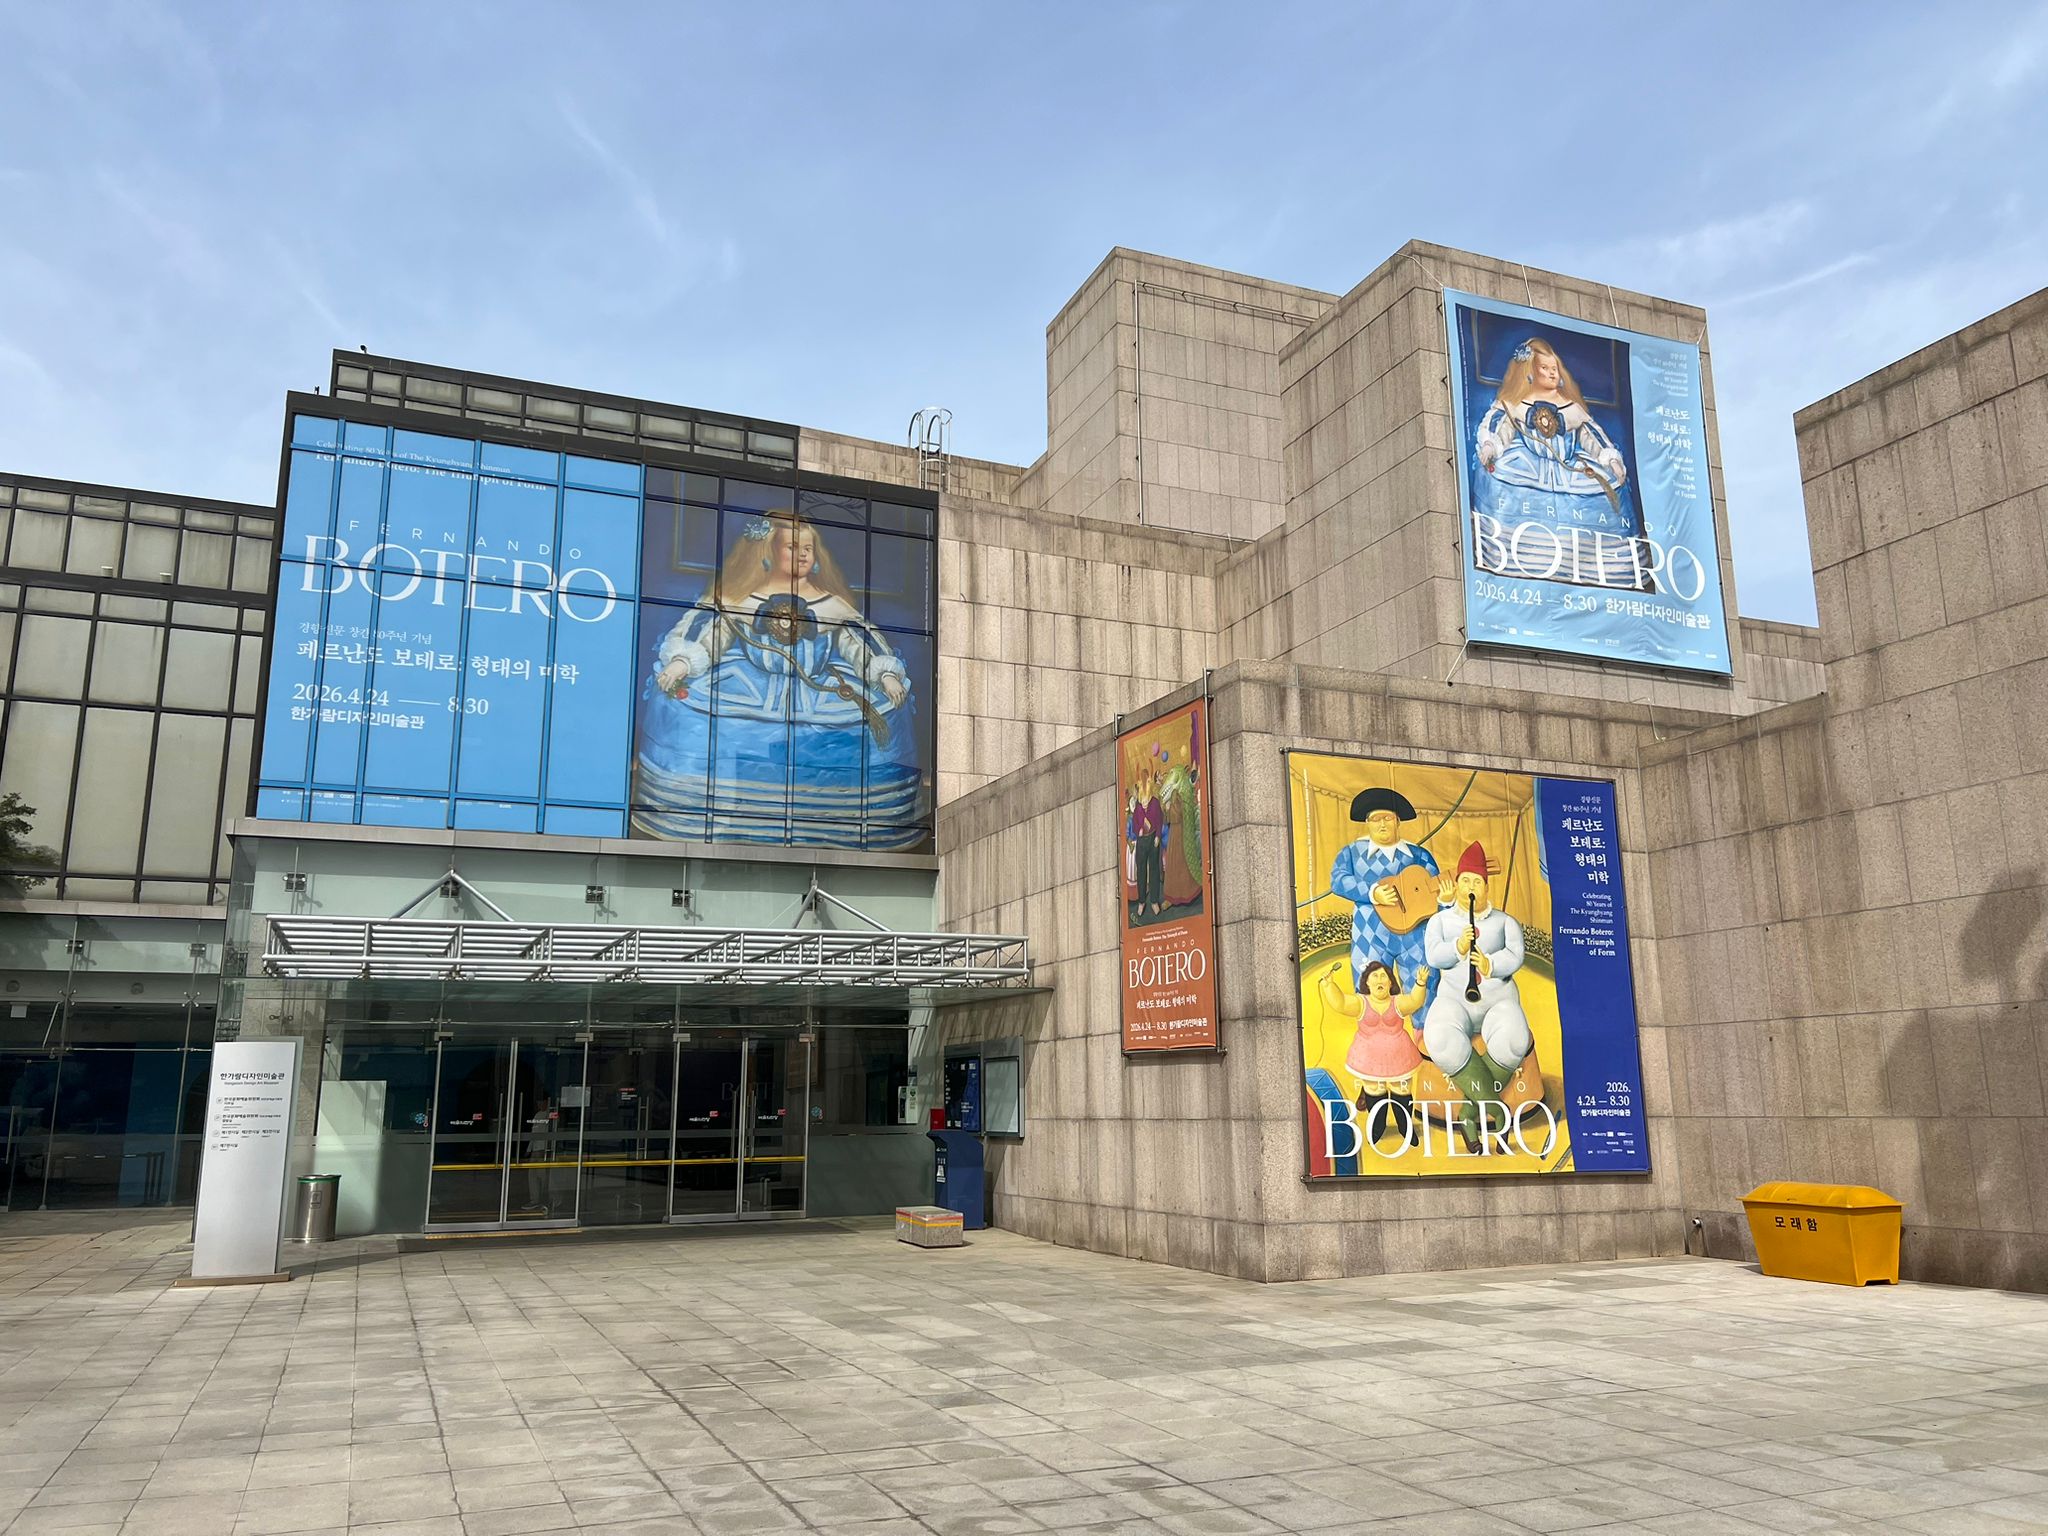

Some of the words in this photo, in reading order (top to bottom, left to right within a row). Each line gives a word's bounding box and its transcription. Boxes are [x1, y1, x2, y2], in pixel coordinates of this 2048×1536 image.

[475, 462, 511, 473] hinmun
[1498, 498, 1677, 537] FERNANDO
[349, 520, 582, 560] FERNANDO
[1472, 510, 1705, 601] BOTERO
[300, 534, 617, 623] BOTERO
[1475, 580, 1543, 606] 2026.4.24
[1563, 593, 1597, 612] 8.30
[1605, 598, 1711, 630] 한가람디자인미술관
[411, 632, 432, 645] 기념
[296, 639, 385, 664] 페르난도
[391, 648, 462, 672] 보테로:
[471, 655, 531, 681] 형태의
[538, 663, 580, 685] 미학
[292, 683, 390, 707] 2026.4.24
[447, 696, 489, 715] 8.30
[291, 706, 425, 730] 한가람디자인미술관
[1561, 817, 1605, 832] 페르난도
[1570, 835, 1606, 850] 보테로:
[1574, 853, 1607, 868] 형태의
[1587, 871, 1609, 885] 미학
[1559, 926, 1590, 935] Fernando
[1590, 927, 1615, 936] Botero:
[1136, 938, 1195, 955] FERNANDO
[1571, 937, 1585, 945] The
[1585, 937, 1615, 948] Triumph
[1589, 948, 1597, 956] of
[1597, 948, 1616, 956] Form
[1129, 948, 1206, 989] BOTERO
[1354, 1080, 1526, 1092] FERNANDO
[1606, 1081, 1631, 1093] 2026.
[1576, 1095, 1596, 1106] 4.24
[1609, 1095, 1630, 1106] 8.30
[1324, 1098, 1557, 1159] BOTERO
[1774, 1216, 1818, 1232] 모래함
